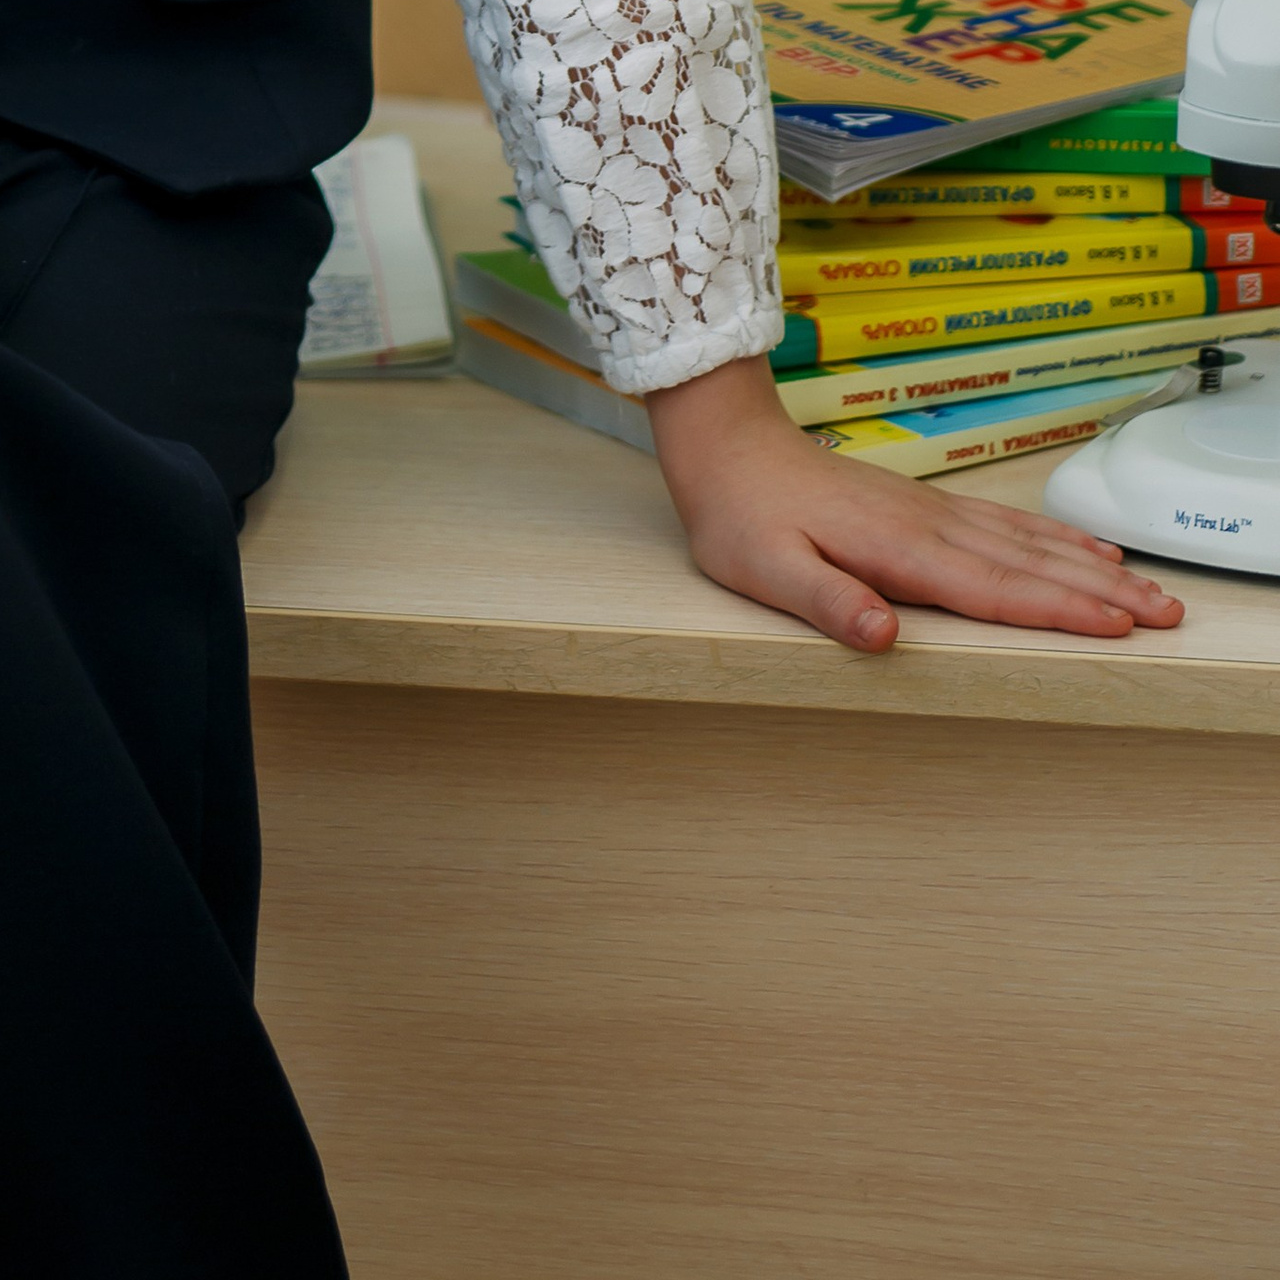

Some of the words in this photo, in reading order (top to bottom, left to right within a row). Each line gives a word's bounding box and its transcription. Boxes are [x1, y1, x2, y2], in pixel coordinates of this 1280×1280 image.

[774, 46, 861, 77] ВПР
[798, 19, 1002, 90] МАТЕМАТИКЕ
[832, 112, 893, 128] 4
[1049, 138, 1164, 152] РАЗРАБОТКИ
[868, 185, 1036, 206] ФРАЗЕОЛОГИЧЕСКИЙ
[818, 259, 901, 281] СЛОВАРЬ
[908, 249, 1069, 277] ФРАЗЕОЛОГИЧЕСКИЙ
[944, 299, 1093, 334] ФРАЗЕОЛОГИЧЕСКИЙ
[860, 316, 938, 341] СЛОВАРЬ
[888, 386, 897, 402] 3
[905, 370, 1011, 400] МАТЕМАТИКА
[842, 389, 885, 407] класс
[1002, 420, 1100, 453] МАТЕМАТИКА
[946, 446, 985, 462] класс
[988, 441, 996, 456] 1
[1174, 509, 1192, 531] My
[1194, 512, 1217, 531] First
